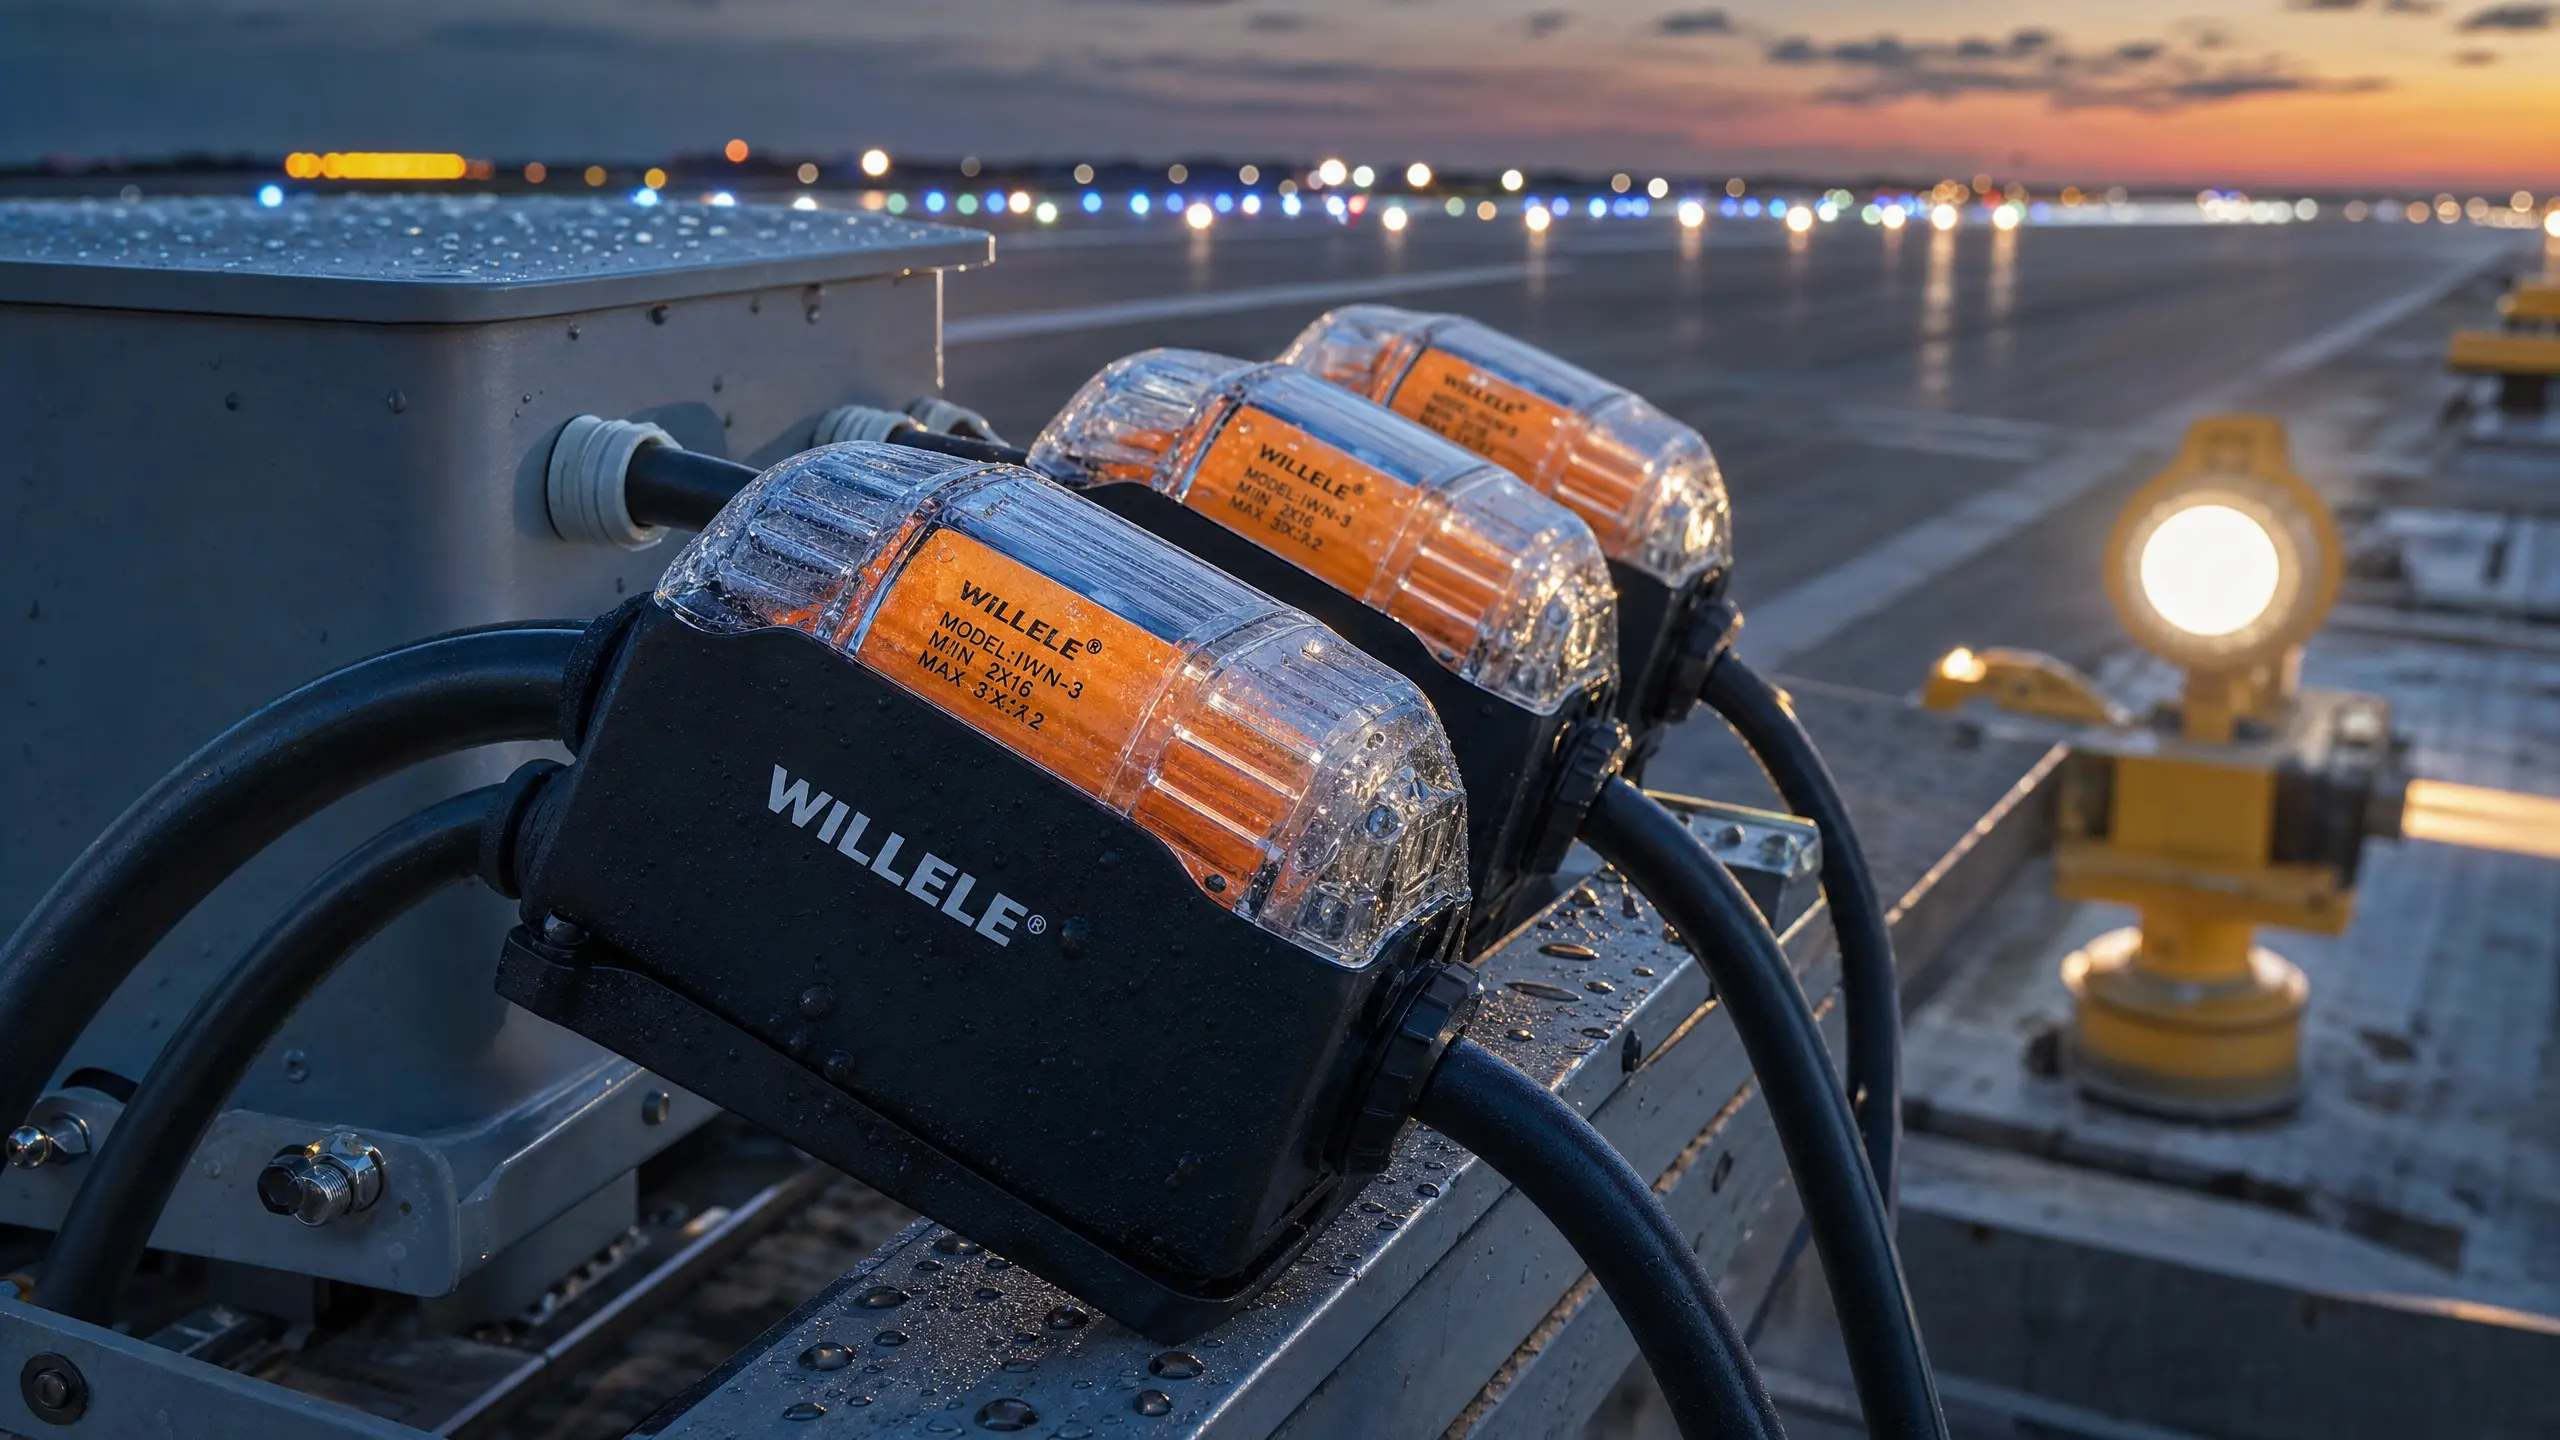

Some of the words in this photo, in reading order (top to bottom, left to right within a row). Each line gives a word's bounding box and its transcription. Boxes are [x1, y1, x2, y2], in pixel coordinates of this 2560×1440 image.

[1228, 495, 1264, 521] MAX
[960, 580, 1102, 661] WILLELE®
[917, 650, 966, 687] MAX
[939, 611, 1083, 699] MODEL:IWN-3
[985, 663, 1033, 697] 2X16
[768, 763, 1047, 948] WILLELE®
